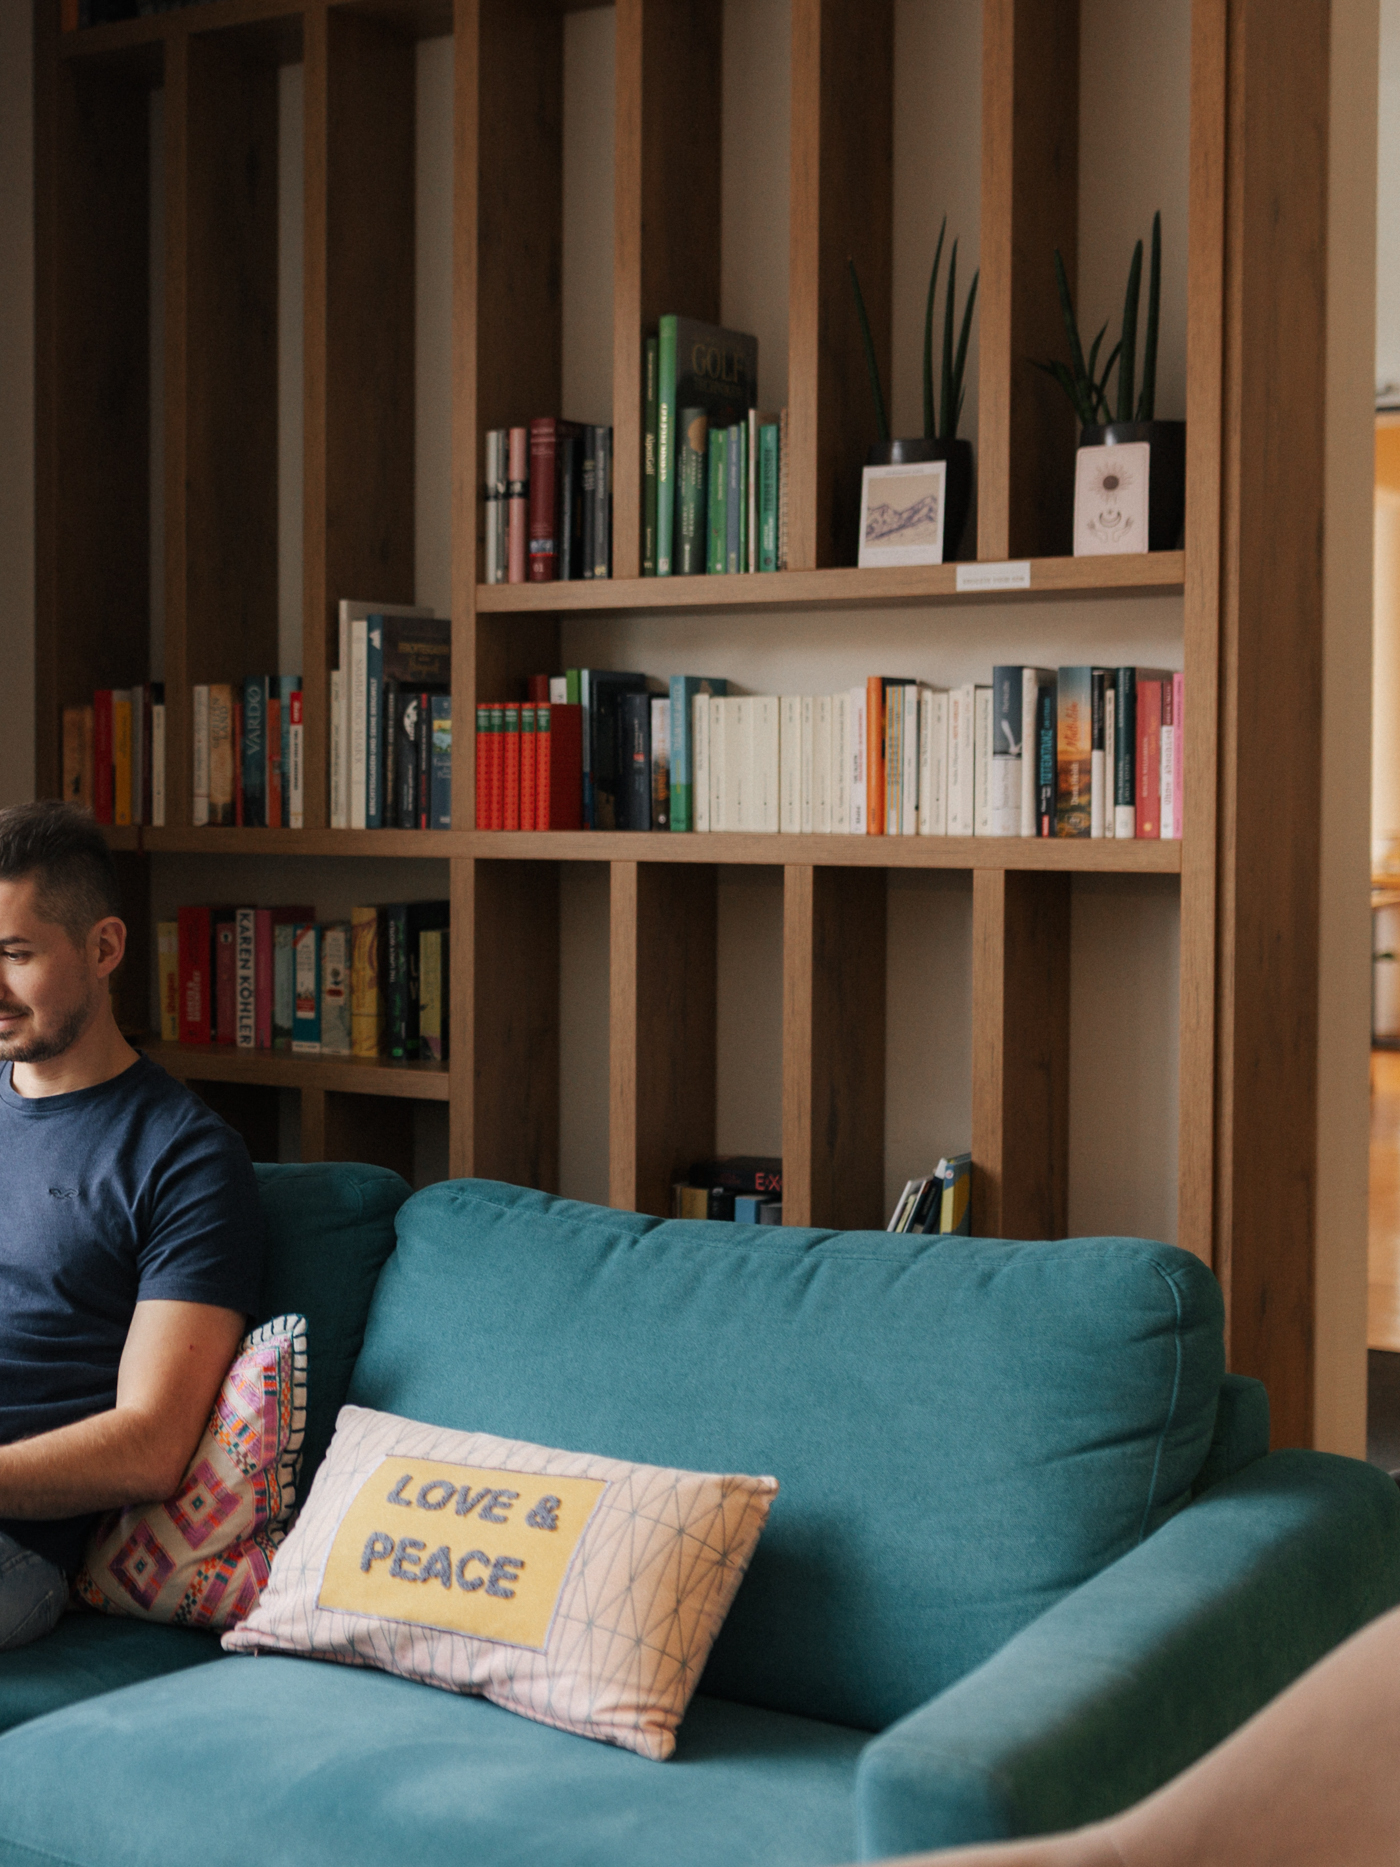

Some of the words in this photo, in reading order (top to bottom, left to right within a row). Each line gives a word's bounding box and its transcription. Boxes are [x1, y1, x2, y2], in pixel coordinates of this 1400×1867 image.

[692, 343, 745, 383] GOLF
[645, 433, 656, 476] AlpenGolf
[354, 659, 363, 725] SAMMLUNG
[370, 677, 378, 715] BERGWELT
[246, 685, 262, 756] VARDØ
[370, 716, 378, 738] SEINE
[354, 729, 363, 764] MARK
[370, 739, 378, 754] UND
[1039, 728, 1053, 785] TOTENTANZ
[1163, 729, 1172, 775] Abschied
[369, 755, 378, 816] BERCHTESGADEN
[1070, 762, 1080, 785] Heldt
[1163, 781, 1172, 806] Ohne
[239, 912, 251, 970] KAREN
[238, 976, 255, 1045] KÖHLER
[386, 1473, 519, 1525] LOVE
[524, 1494, 562, 1532] &
[359, 1531, 526, 1600] PEACE
